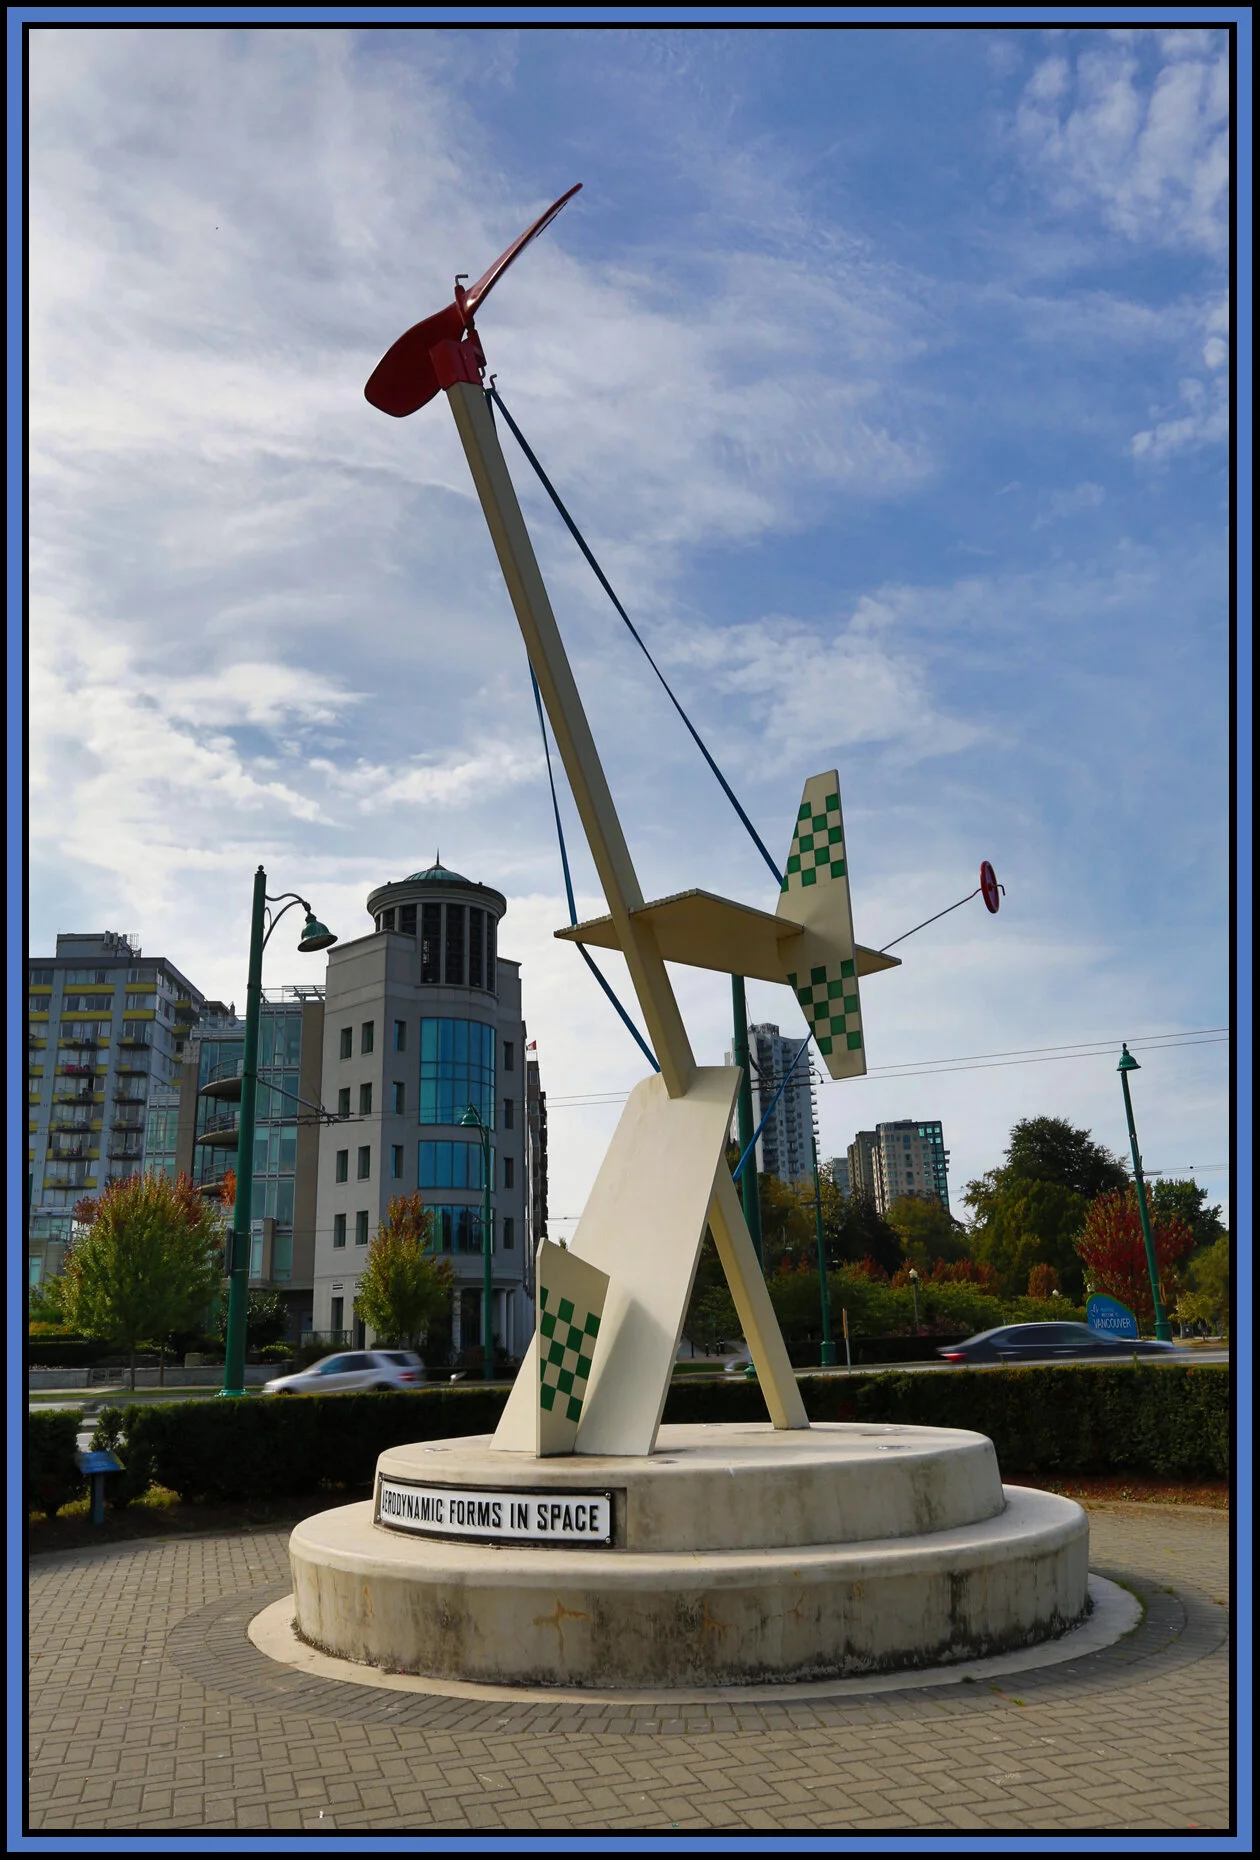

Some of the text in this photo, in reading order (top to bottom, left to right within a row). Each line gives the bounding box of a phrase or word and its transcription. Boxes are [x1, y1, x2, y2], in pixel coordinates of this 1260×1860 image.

[1093, 1318, 1131, 1328] VANCOUVER
[449, 1499, 502, 1528] FORMS
[510, 1503, 529, 1530] IN
[537, 1503, 600, 1532] SPACE
